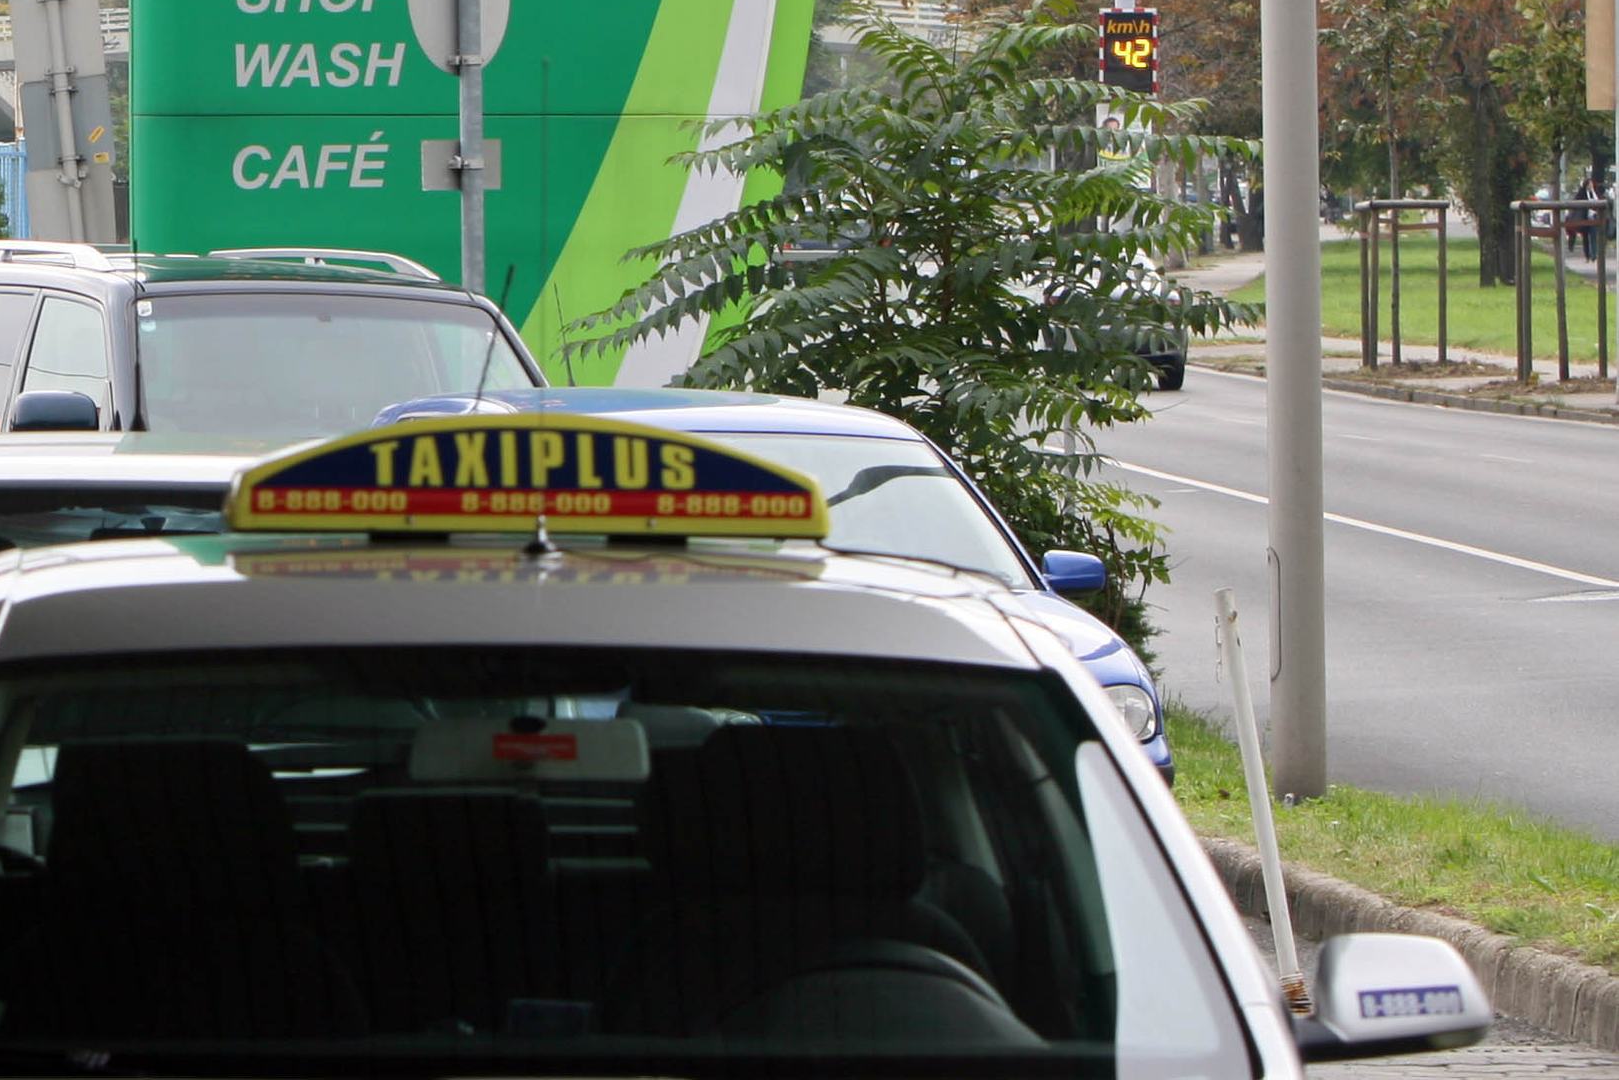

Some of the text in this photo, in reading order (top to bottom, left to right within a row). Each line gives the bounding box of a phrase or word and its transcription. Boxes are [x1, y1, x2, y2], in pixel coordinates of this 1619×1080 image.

[235, 43, 405, 87] WASH
[1114, 38, 1150, 68] 42
[233, 131, 390, 189] CAFÉ
[370, 431, 696, 490] TAXIPLUS
